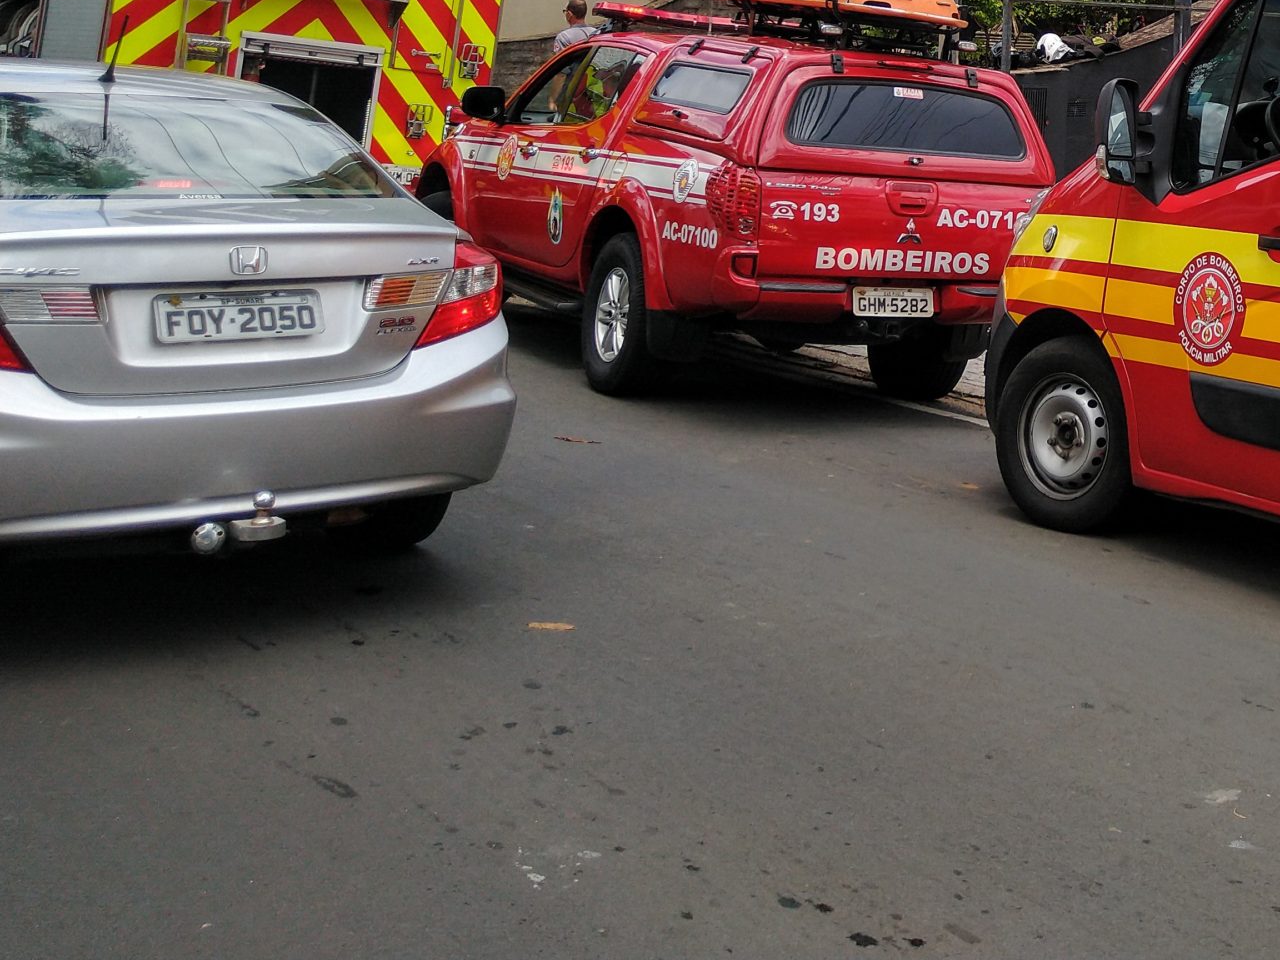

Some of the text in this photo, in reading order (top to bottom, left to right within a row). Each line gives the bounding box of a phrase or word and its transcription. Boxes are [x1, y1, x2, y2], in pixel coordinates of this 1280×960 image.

[561, 154, 575, 172] 193
[800, 202, 840, 223] 193
[936, 208, 1026, 230] AC-071
[662, 220, 718, 249] AC-07100
[408, 256, 440, 266] LXR
[815, 246, 990, 275] BOMBEIROS
[1175, 255, 1244, 313] CORPO DE BOMBEIROS
[1178, 329, 1233, 363] POLÍCIA MILITAR
